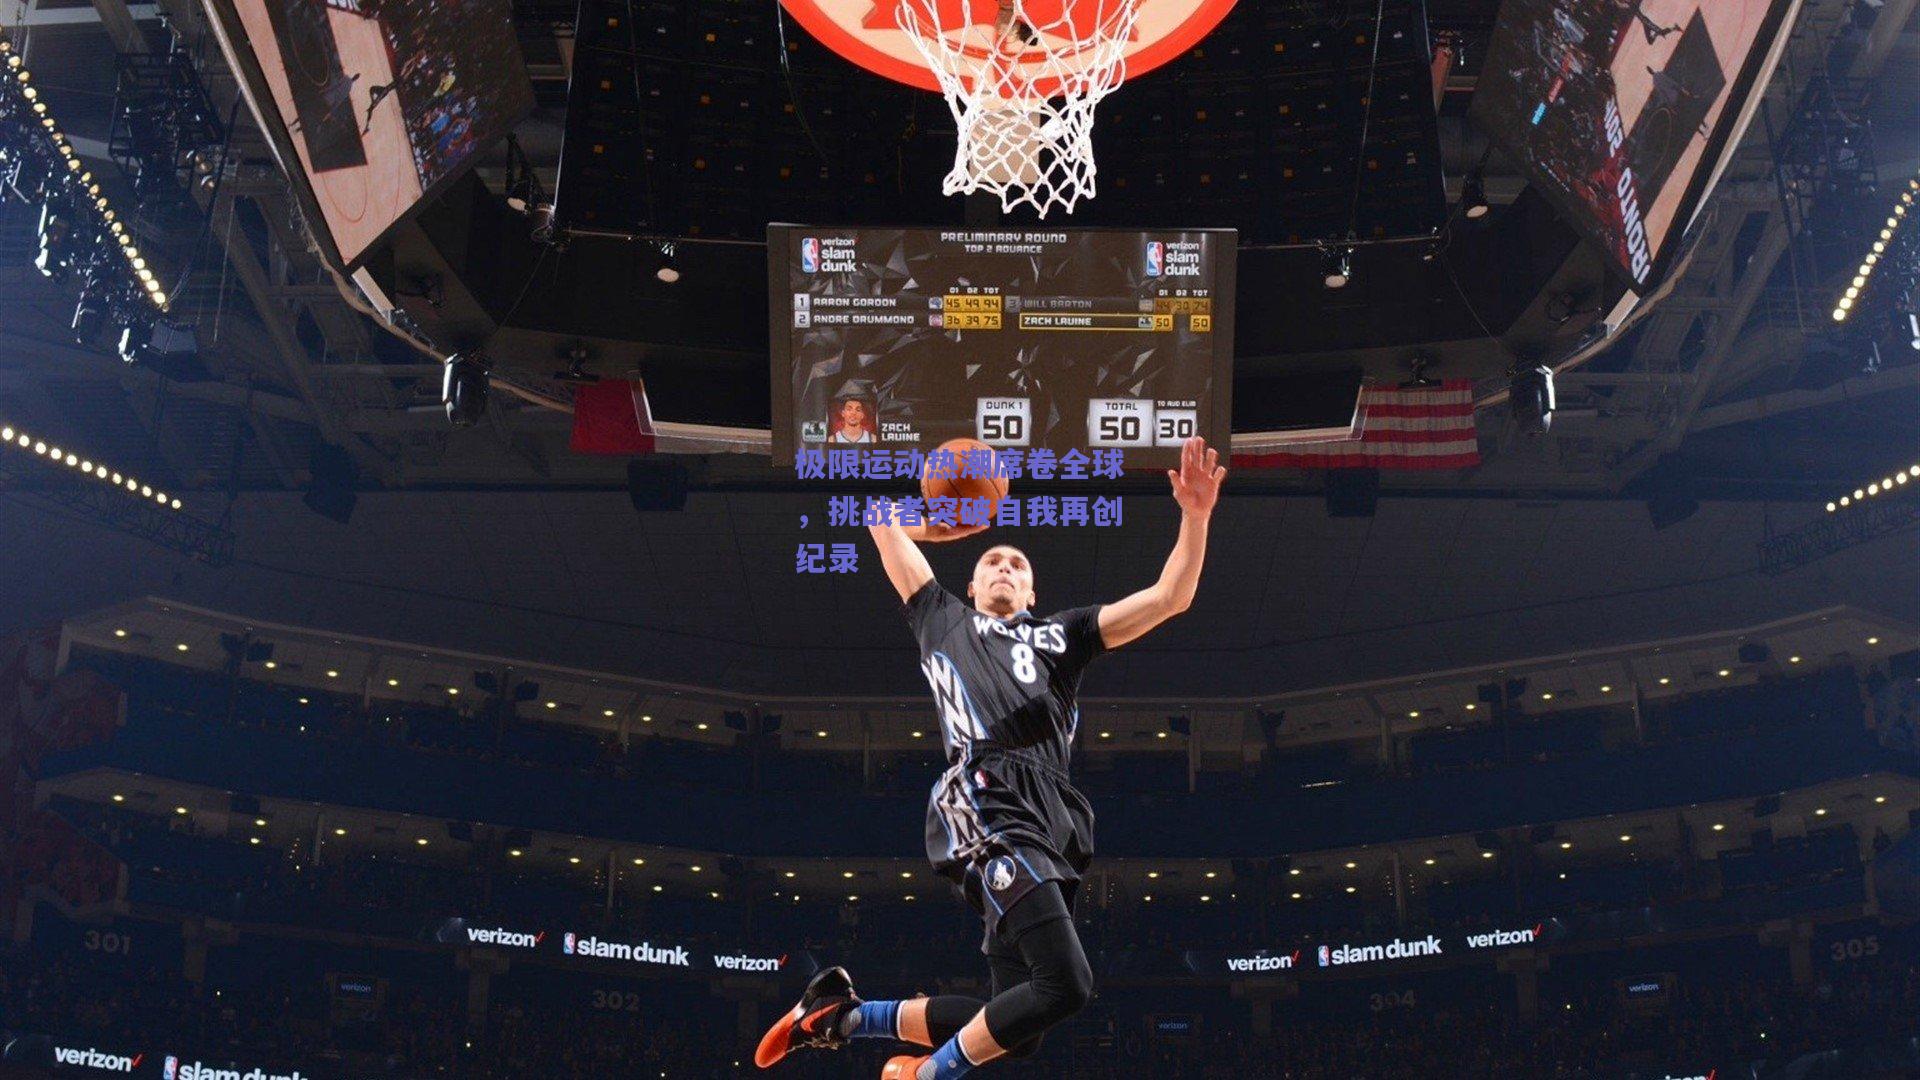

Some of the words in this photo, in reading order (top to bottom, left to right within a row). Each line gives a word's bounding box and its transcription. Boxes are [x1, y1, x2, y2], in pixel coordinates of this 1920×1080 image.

[821, 237, 855, 246] verizon
[940, 232, 1021, 242] PRELIMINARY
[1025, 233, 1067, 243] ROUND
[965, 244, 984, 253] TOP
[986, 244, 993, 253] 2
[1165, 241, 1199, 250] verizon
[821, 246, 855, 259] slam
[1165, 250, 1199, 263] slam
[821, 259, 857, 272] dunk
[1165, 262, 1200, 275] dunk
[813, 298, 850, 307] AARON
[852, 298, 896, 307] GORDON
[946, 298, 960, 308] 45
[965, 298, 980, 308] 49
[983, 298, 999, 308] 94
[1024, 299, 1047, 309] WILL
[1050, 299, 1092, 309] BARTON
[798, 314, 806, 324] 2
[813, 315, 849, 324] ANDRE
[852, 315, 915, 324] DRUMMOND
[965, 315, 980, 325] 39
[984, 315, 999, 325] 75
[1024, 316, 1052, 326] ZACH
[1156, 317, 1169, 327] 50
[1193, 318, 1208, 328] 50
[986, 401, 1015, 410] DUNK
[1105, 402, 1138, 411] TOTAL
[881, 422, 911, 432] ZACH
[983, 415, 1023, 440] 50
[1100, 416, 1141, 440] 50
[1160, 418, 1193, 438] 30
[1011, 643, 1037, 684] 8
[467, 928, 536, 948] verizon
[1466, 928, 1534, 948] verizon
[577, 936, 631, 960] slam
[632, 941, 690, 966] dunk
[1331, 944, 1384, 965] slam
[1385, 934, 1443, 959] dunk
[714, 953, 779, 971] verizon
[1227, 954, 1292, 971] verizon
[340, 982, 372, 993] verizon
[1629, 982, 1659, 993] verizon
[1158, 1020, 1188, 1030] verizon
[54, 1046, 132, 1072] verizon
